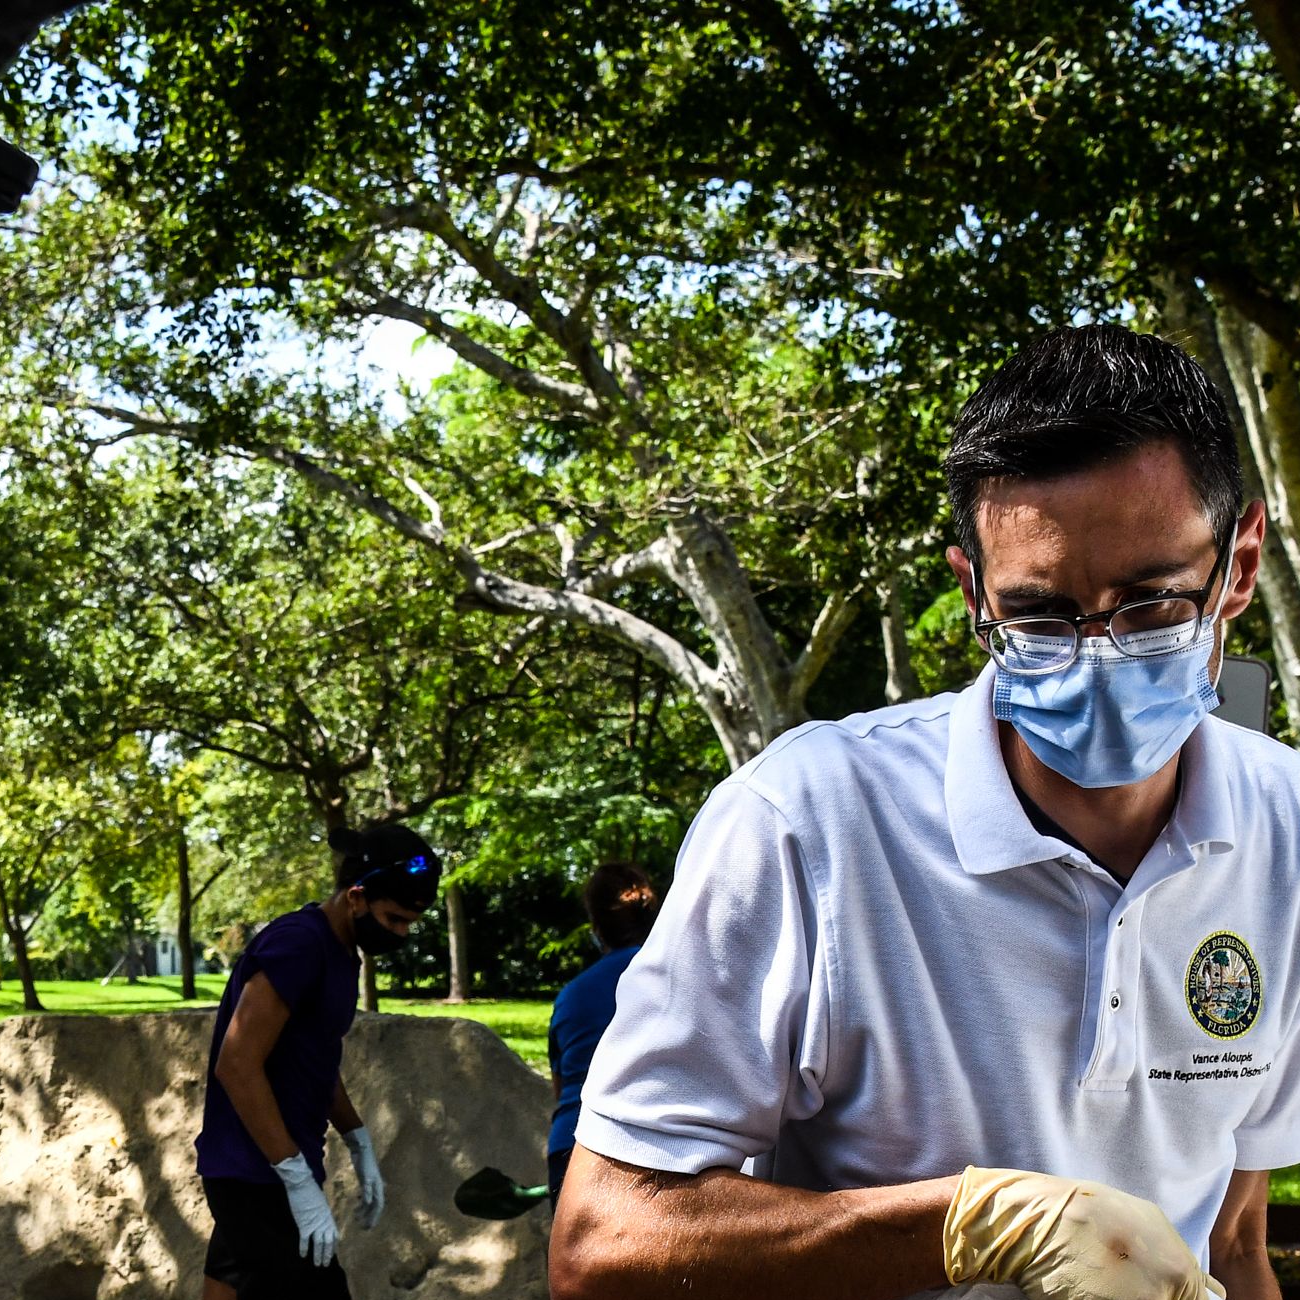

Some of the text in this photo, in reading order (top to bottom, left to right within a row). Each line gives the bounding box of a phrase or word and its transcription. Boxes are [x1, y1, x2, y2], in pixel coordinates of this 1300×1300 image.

[1189, 937, 1260, 993] HOUSE OF REPRESENTATIVES
[1208, 1022, 1247, 1035] FLORIDA
[1192, 1052, 1253, 1065] Vance Aloupis
[1148, 1068, 1172, 1080] State
[1173, 1069, 1239, 1083] Representative,
